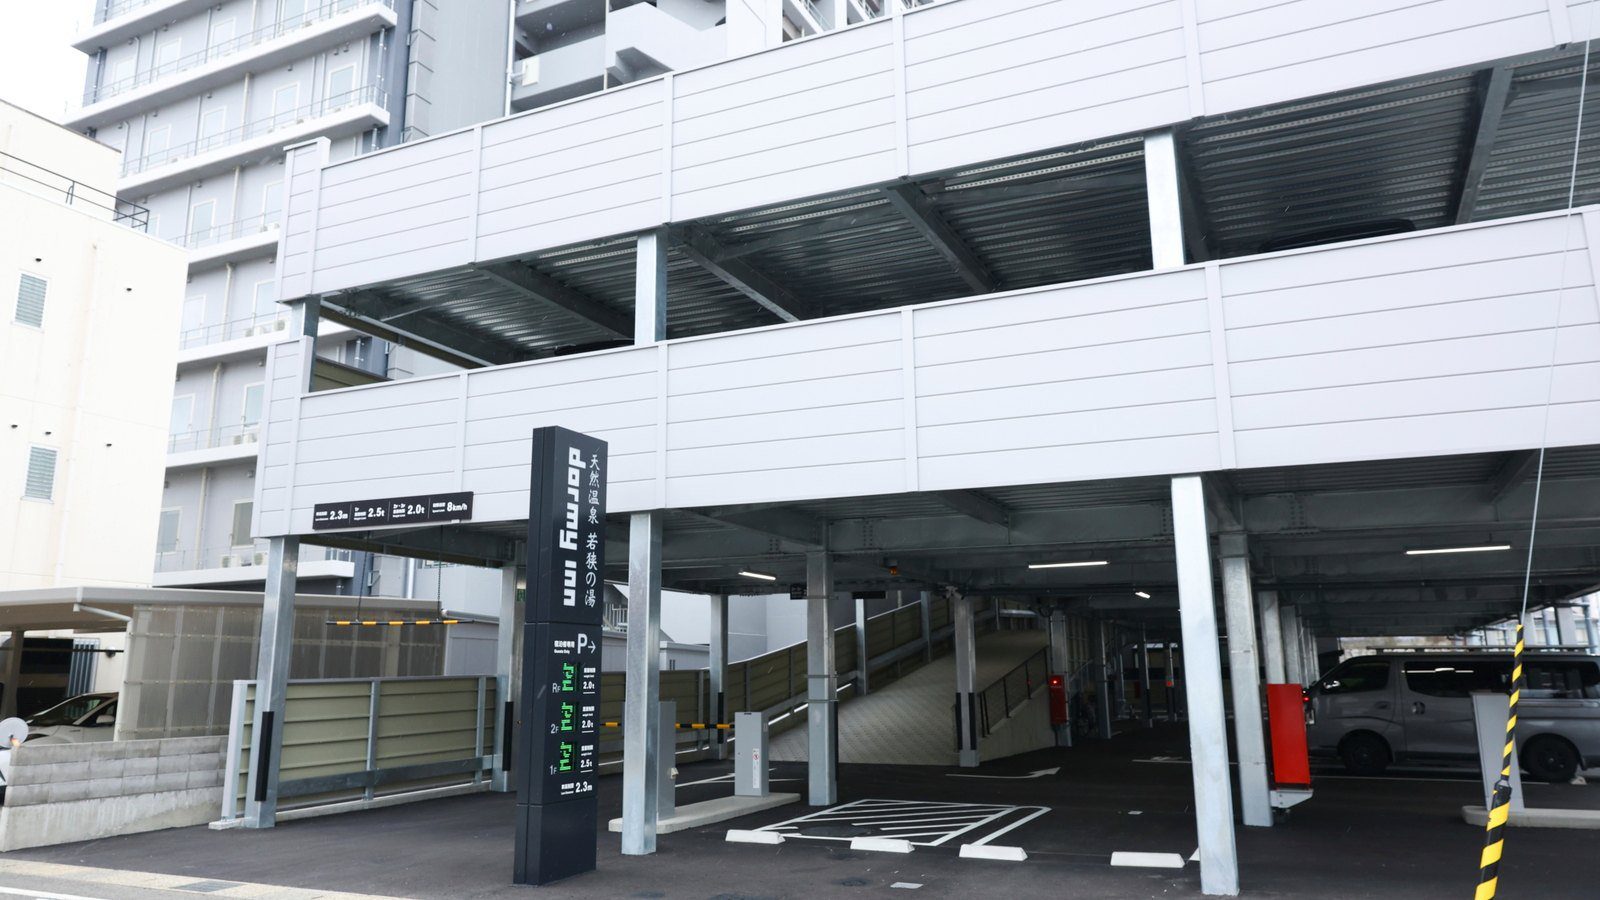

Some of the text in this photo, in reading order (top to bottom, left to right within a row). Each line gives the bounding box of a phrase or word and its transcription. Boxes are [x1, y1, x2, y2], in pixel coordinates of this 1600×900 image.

[407, 504, 425, 515] 2.0t
[447, 501, 468, 512] 8km/h
[329, 510, 349, 520] 2.3m
[368, 507, 385, 518] 2.5t
[559, 446, 586, 607] dormy inn
[585, 454, 600, 608] 天然温泉 若狭の湯
[577, 633, 588, 654] P
[583, 681, 595, 690] 2.0t
[550, 723, 559, 734] 2F
[582, 720, 594, 728] 2.0t
[580, 759, 592, 768] 2.5t
[550, 765, 557, 775] 1F
[575, 781, 593, 793] 2.3m
